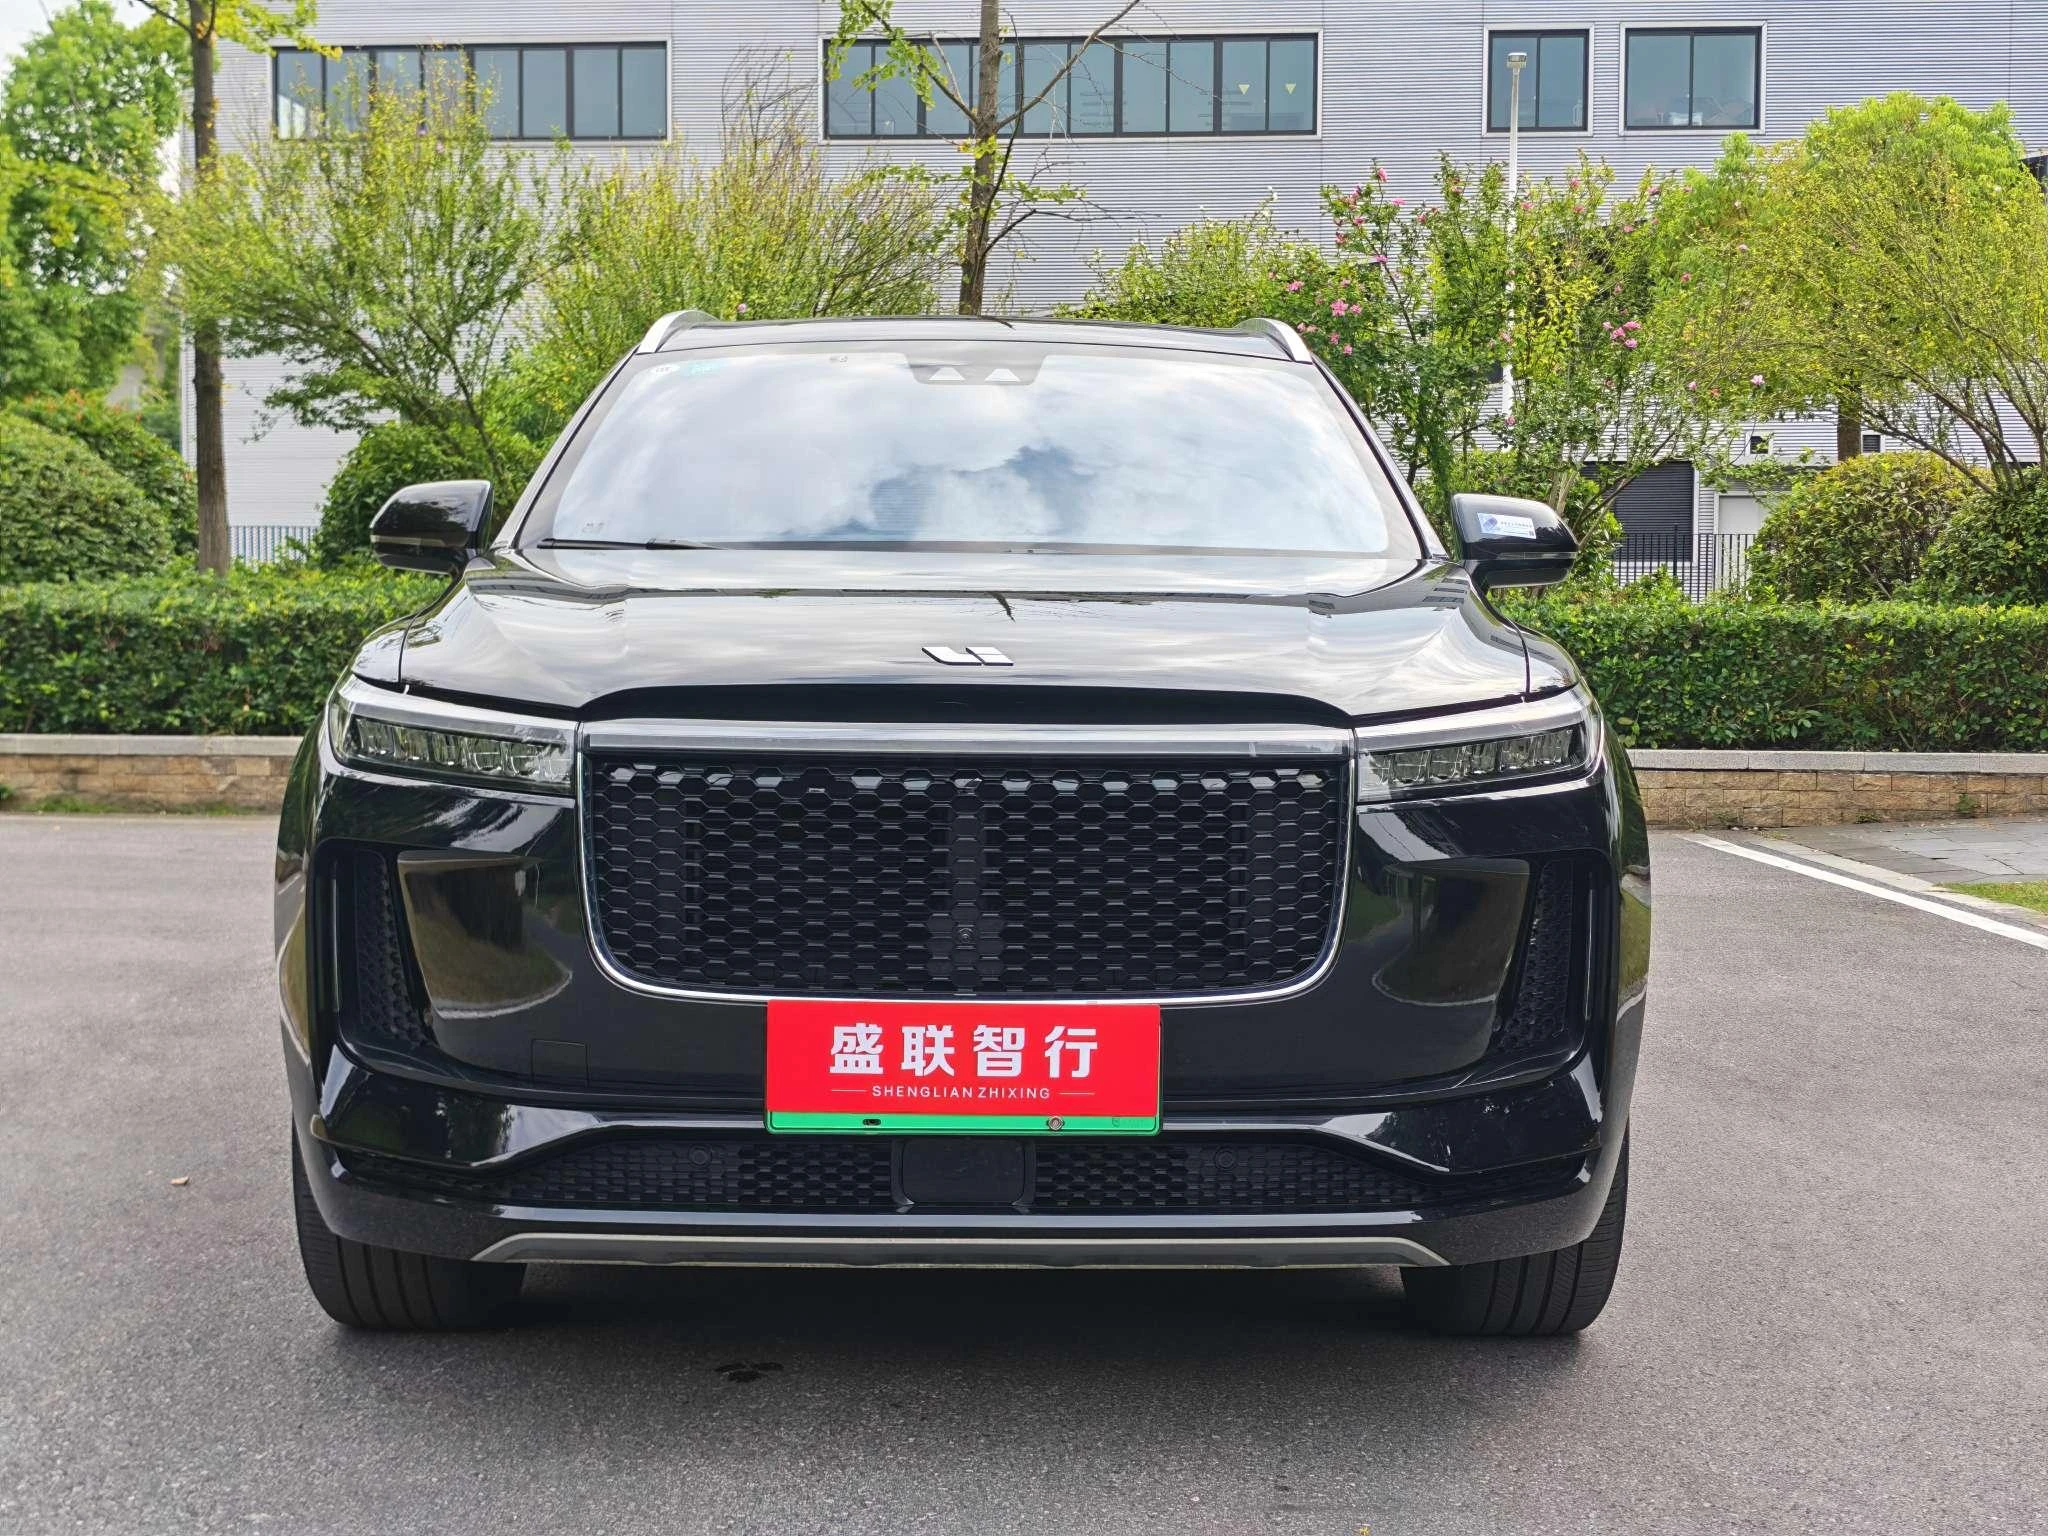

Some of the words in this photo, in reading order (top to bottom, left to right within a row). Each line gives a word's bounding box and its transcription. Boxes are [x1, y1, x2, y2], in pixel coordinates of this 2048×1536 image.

[829, 1022, 1098, 1078] 盛联智行
[872, 1085, 973, 1099] SHENGLIAN
[977, 1087, 1050, 1099] ZHIXING
